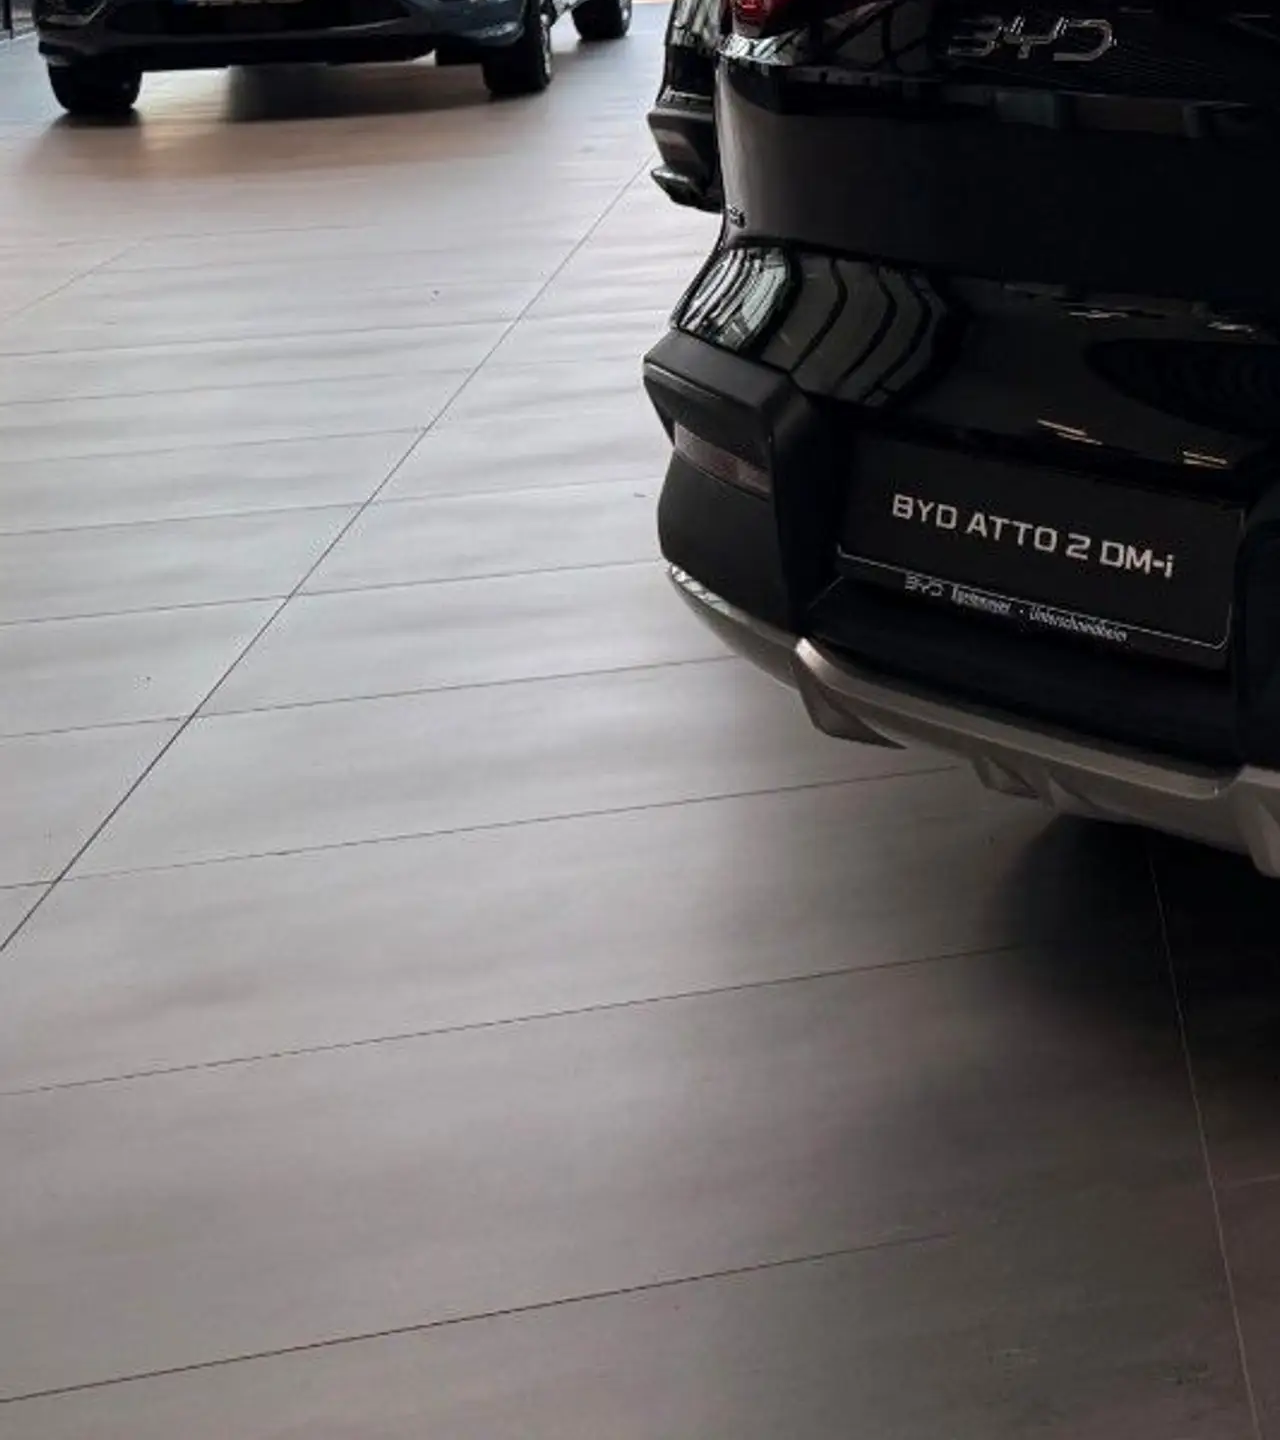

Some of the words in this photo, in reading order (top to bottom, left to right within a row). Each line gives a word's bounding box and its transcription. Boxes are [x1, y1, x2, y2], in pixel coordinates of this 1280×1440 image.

[947, 14, 1117, 62] BYD
[892, 493, 958, 530] BYD
[966, 512, 1059, 553] ATTO
[1065, 532, 1091, 560] 2
[1099, 540, 1175, 579] DM-i
